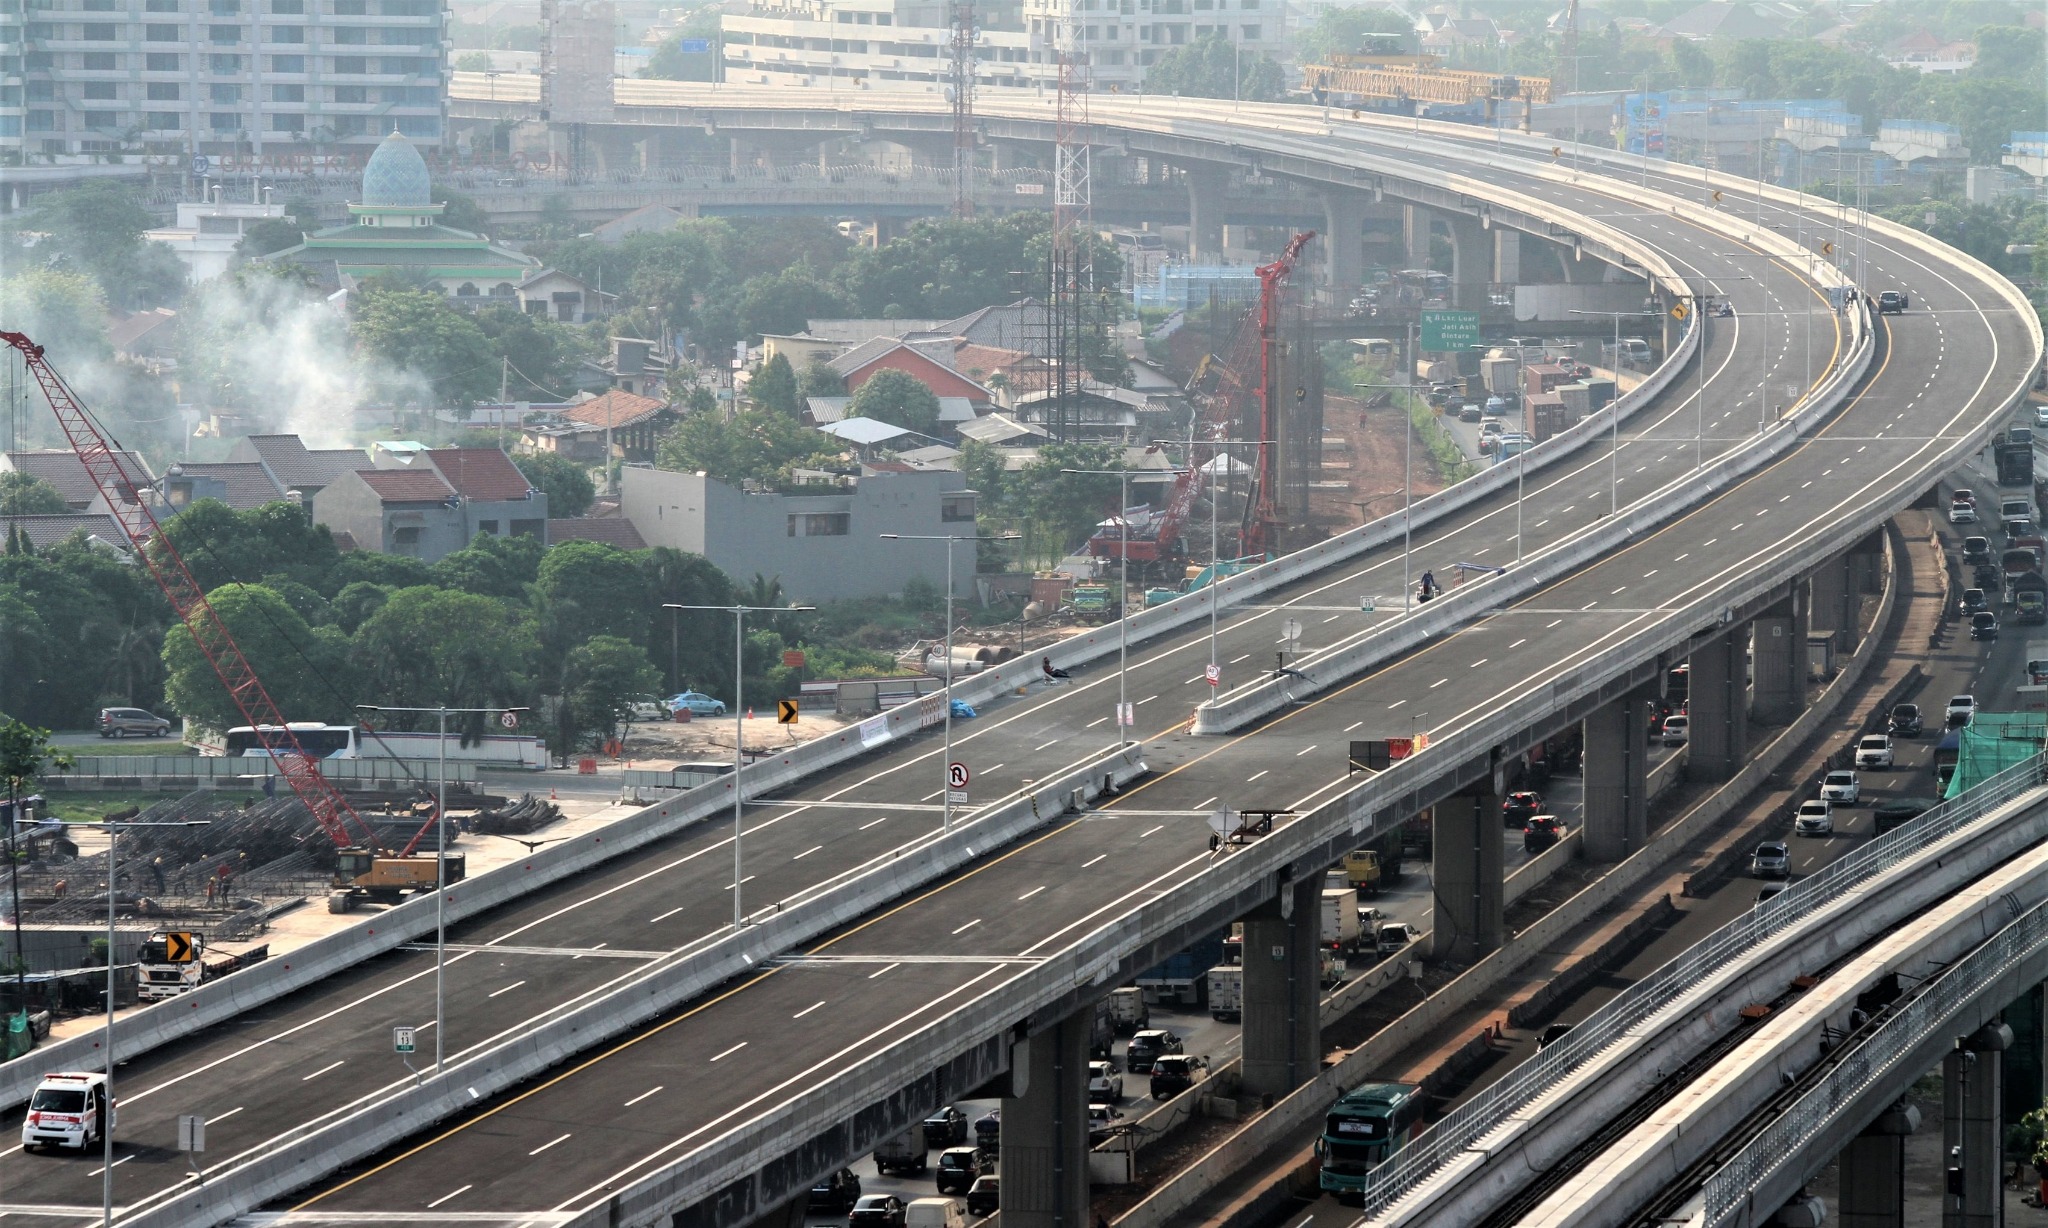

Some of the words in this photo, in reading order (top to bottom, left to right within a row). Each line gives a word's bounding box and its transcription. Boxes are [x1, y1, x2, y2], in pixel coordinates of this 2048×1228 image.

[220, 152, 314, 173] GRAND
[451, 151, 572, 173] LAGOON
[400, 1036, 410, 1045] 13
